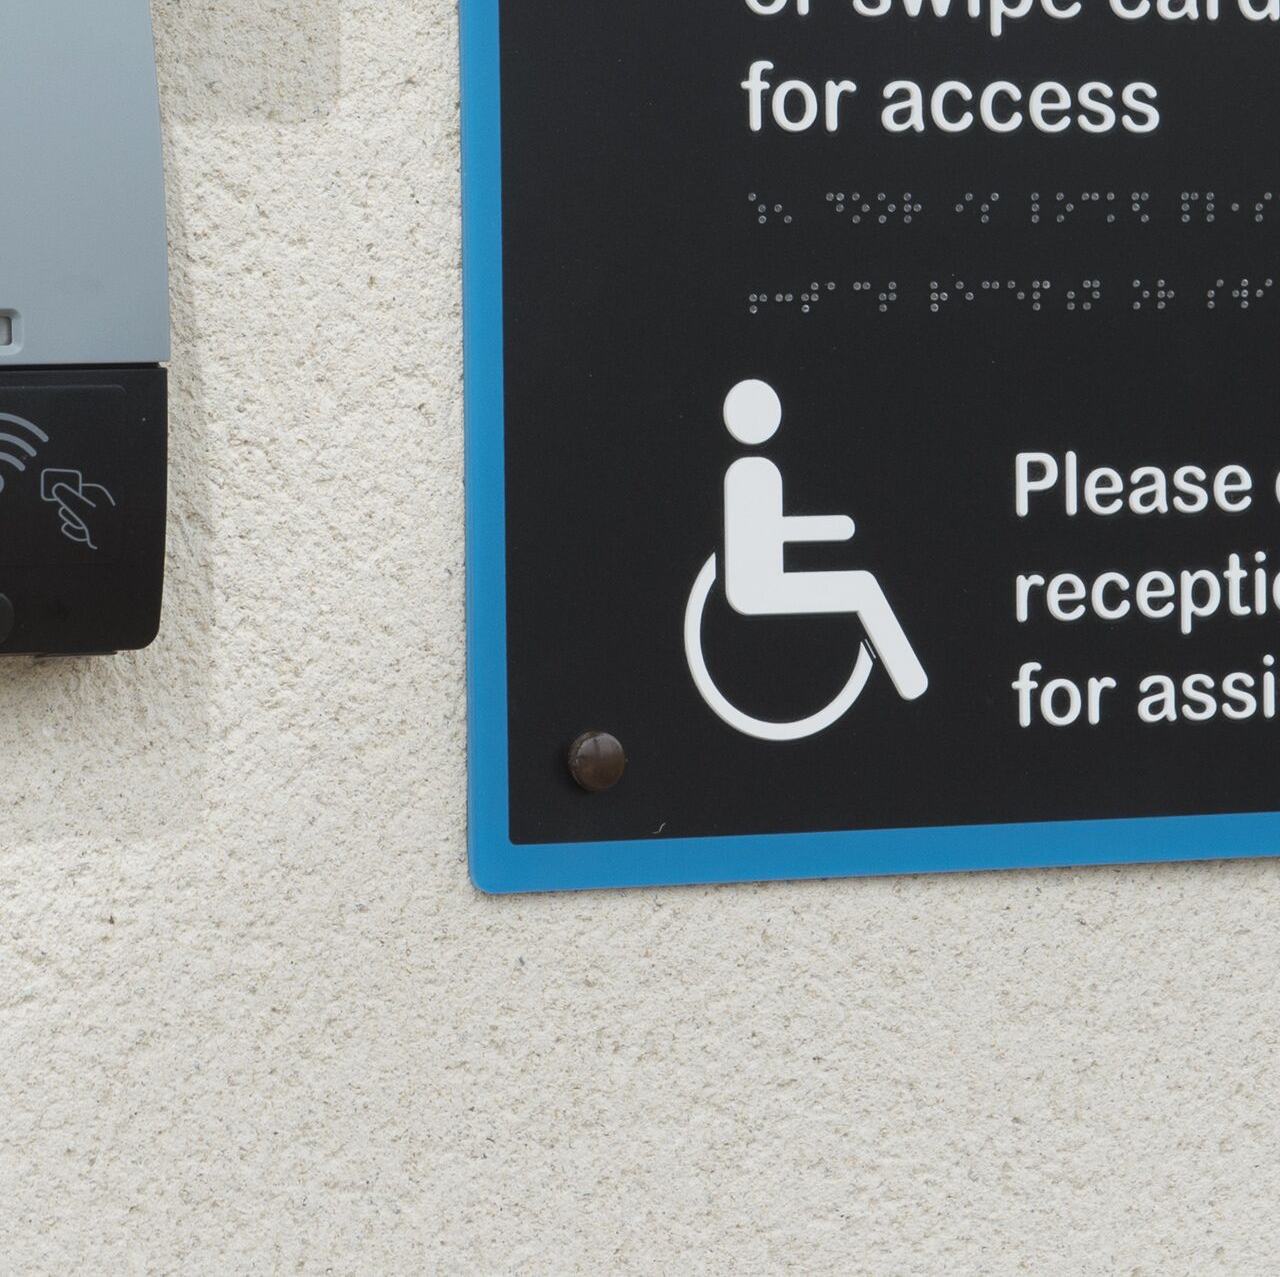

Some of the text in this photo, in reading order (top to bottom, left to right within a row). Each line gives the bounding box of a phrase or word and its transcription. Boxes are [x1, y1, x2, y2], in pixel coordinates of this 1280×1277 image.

[740, 59, 1160, 134] for access
[1015, 450, 1253, 517] Please
[1011, 661, 1117, 728] for
